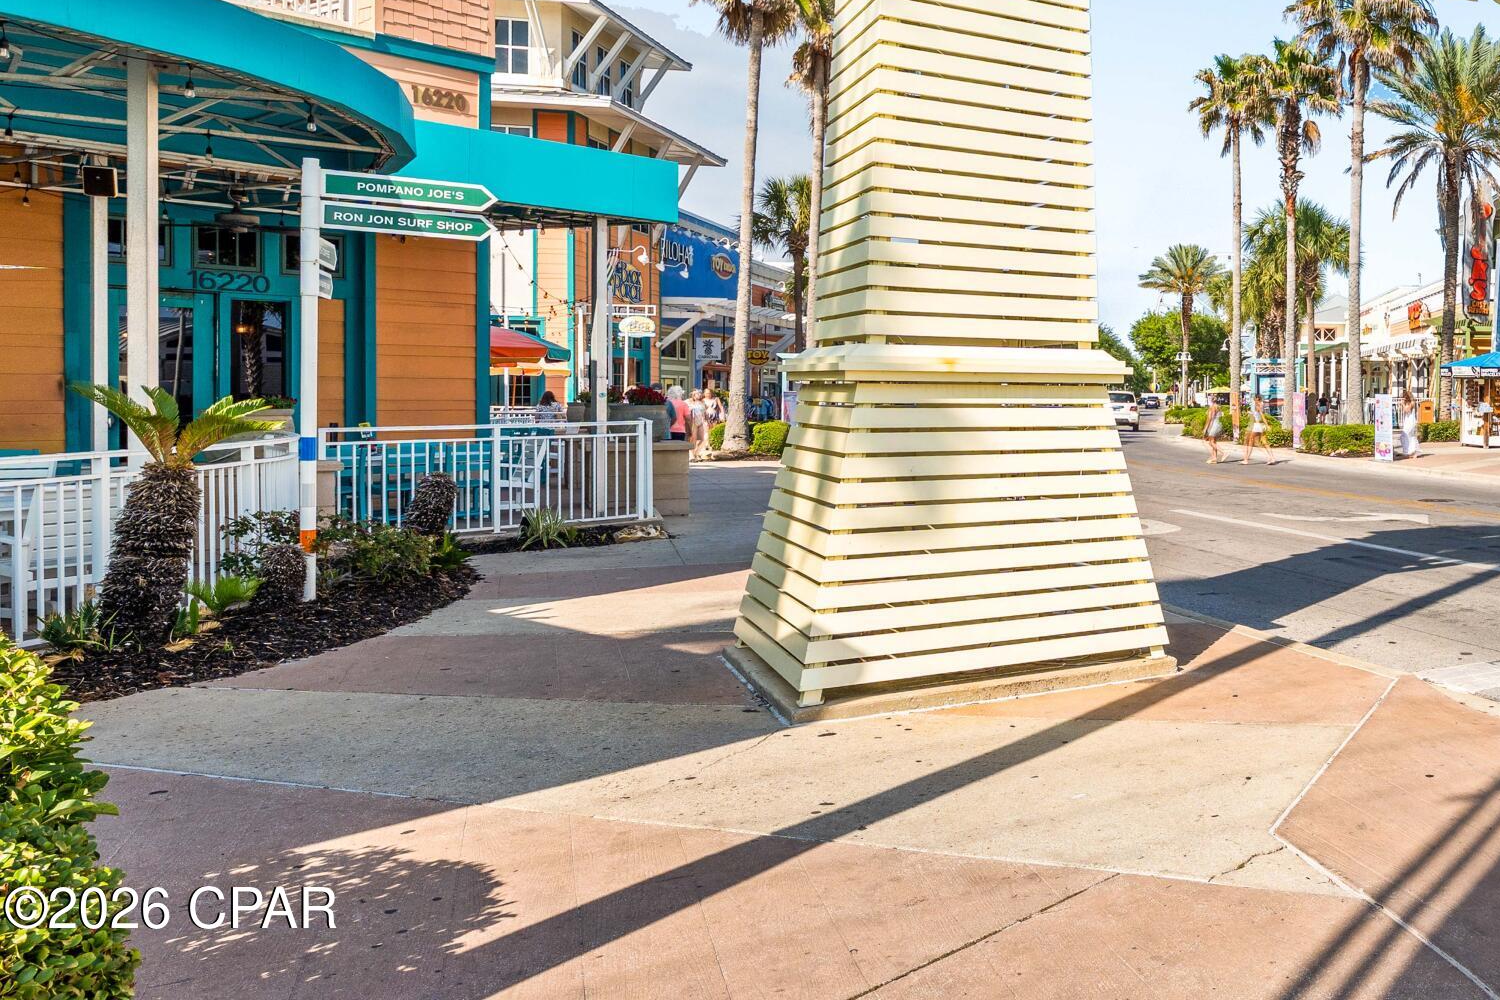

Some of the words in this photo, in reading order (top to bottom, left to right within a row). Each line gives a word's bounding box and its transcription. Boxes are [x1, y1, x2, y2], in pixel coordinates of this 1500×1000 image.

[411, 84, 470, 112] 16220
[356, 181, 424, 198] POMPANO
[427, 188, 465, 201] JOE'S
[333, 211, 364, 223] RON
[367, 214, 395, 226] JON
[397, 217, 434, 229] SURF
[436, 220, 474, 233] SHOP
[660, 237, 690, 266] RILOHA
[187, 270, 271, 293] 16220
